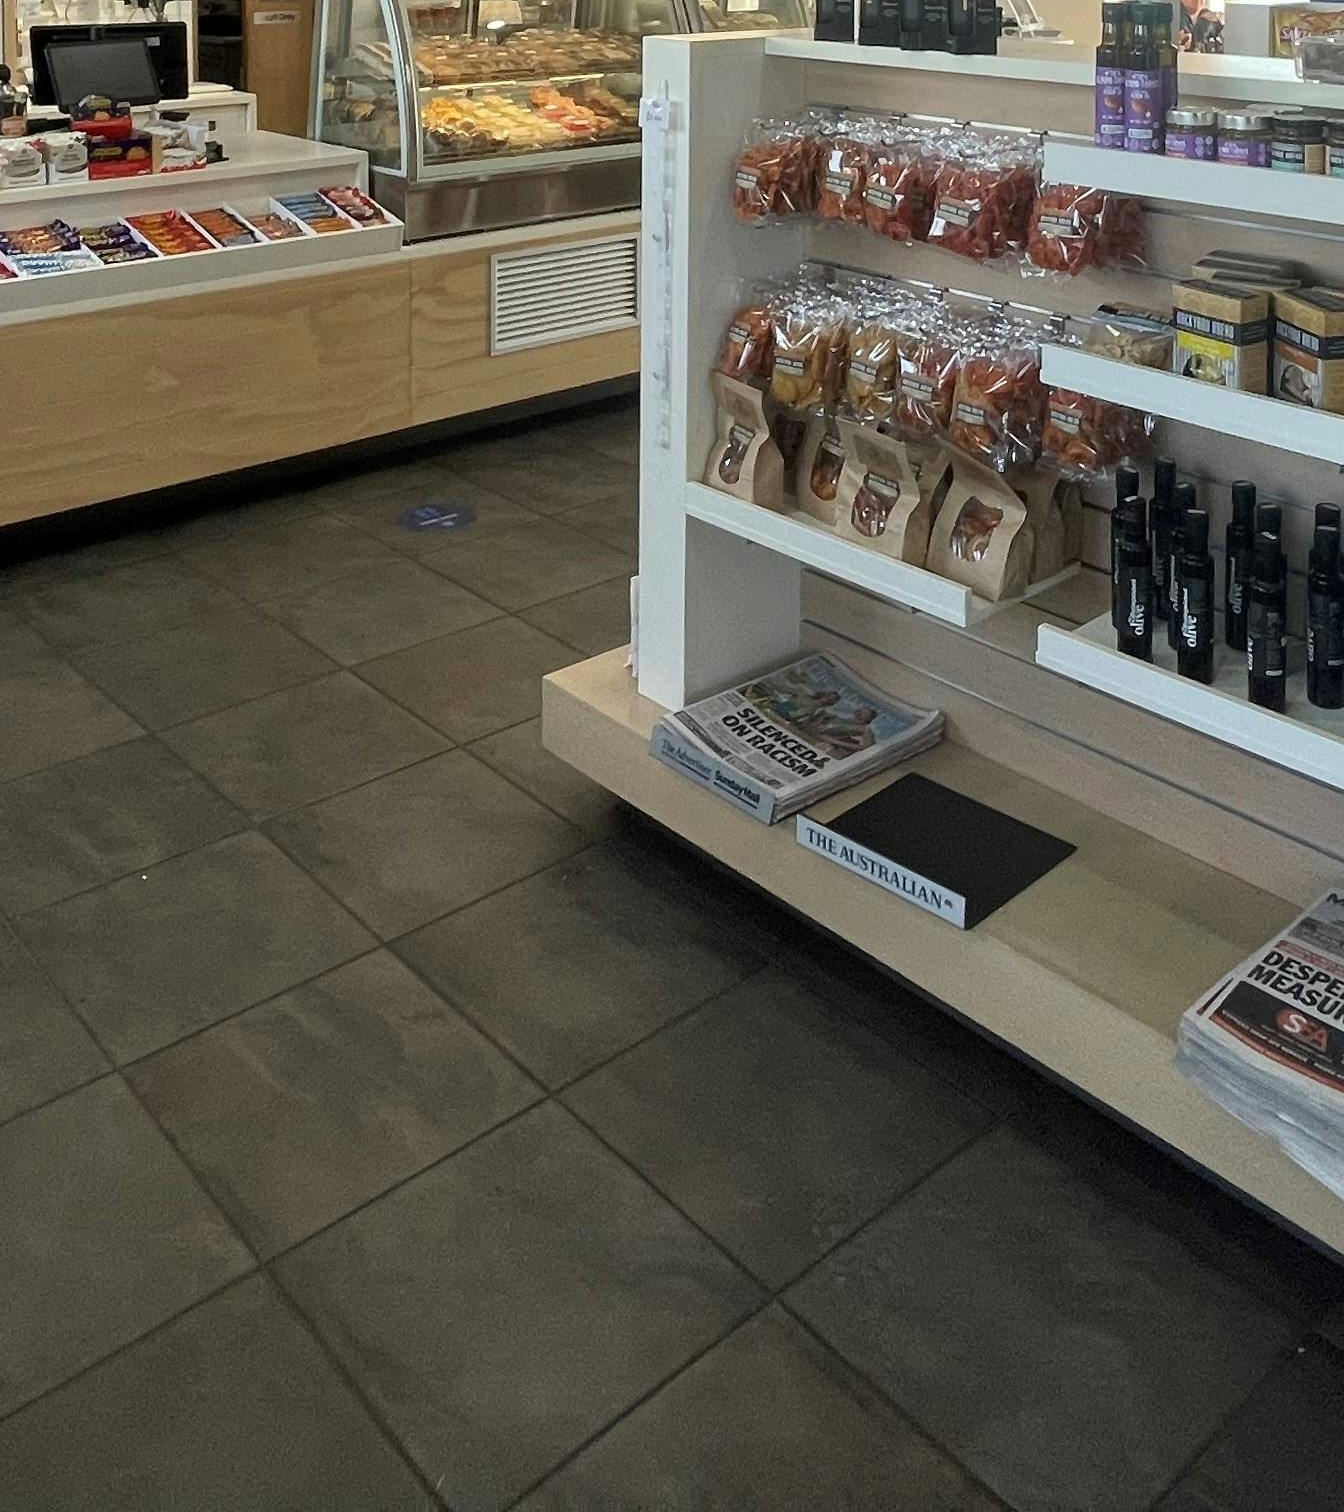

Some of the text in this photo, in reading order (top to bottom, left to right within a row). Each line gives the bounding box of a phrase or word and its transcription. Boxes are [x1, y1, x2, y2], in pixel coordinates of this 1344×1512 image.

[1130, 603, 1145, 636] olive
[1182, 614, 1197, 648] olive
[721, 714, 818, 778] ON RACISM
[736, 707, 819, 768] SILENCED
[806, 827, 942, 910] THE AUSTRALIAN
